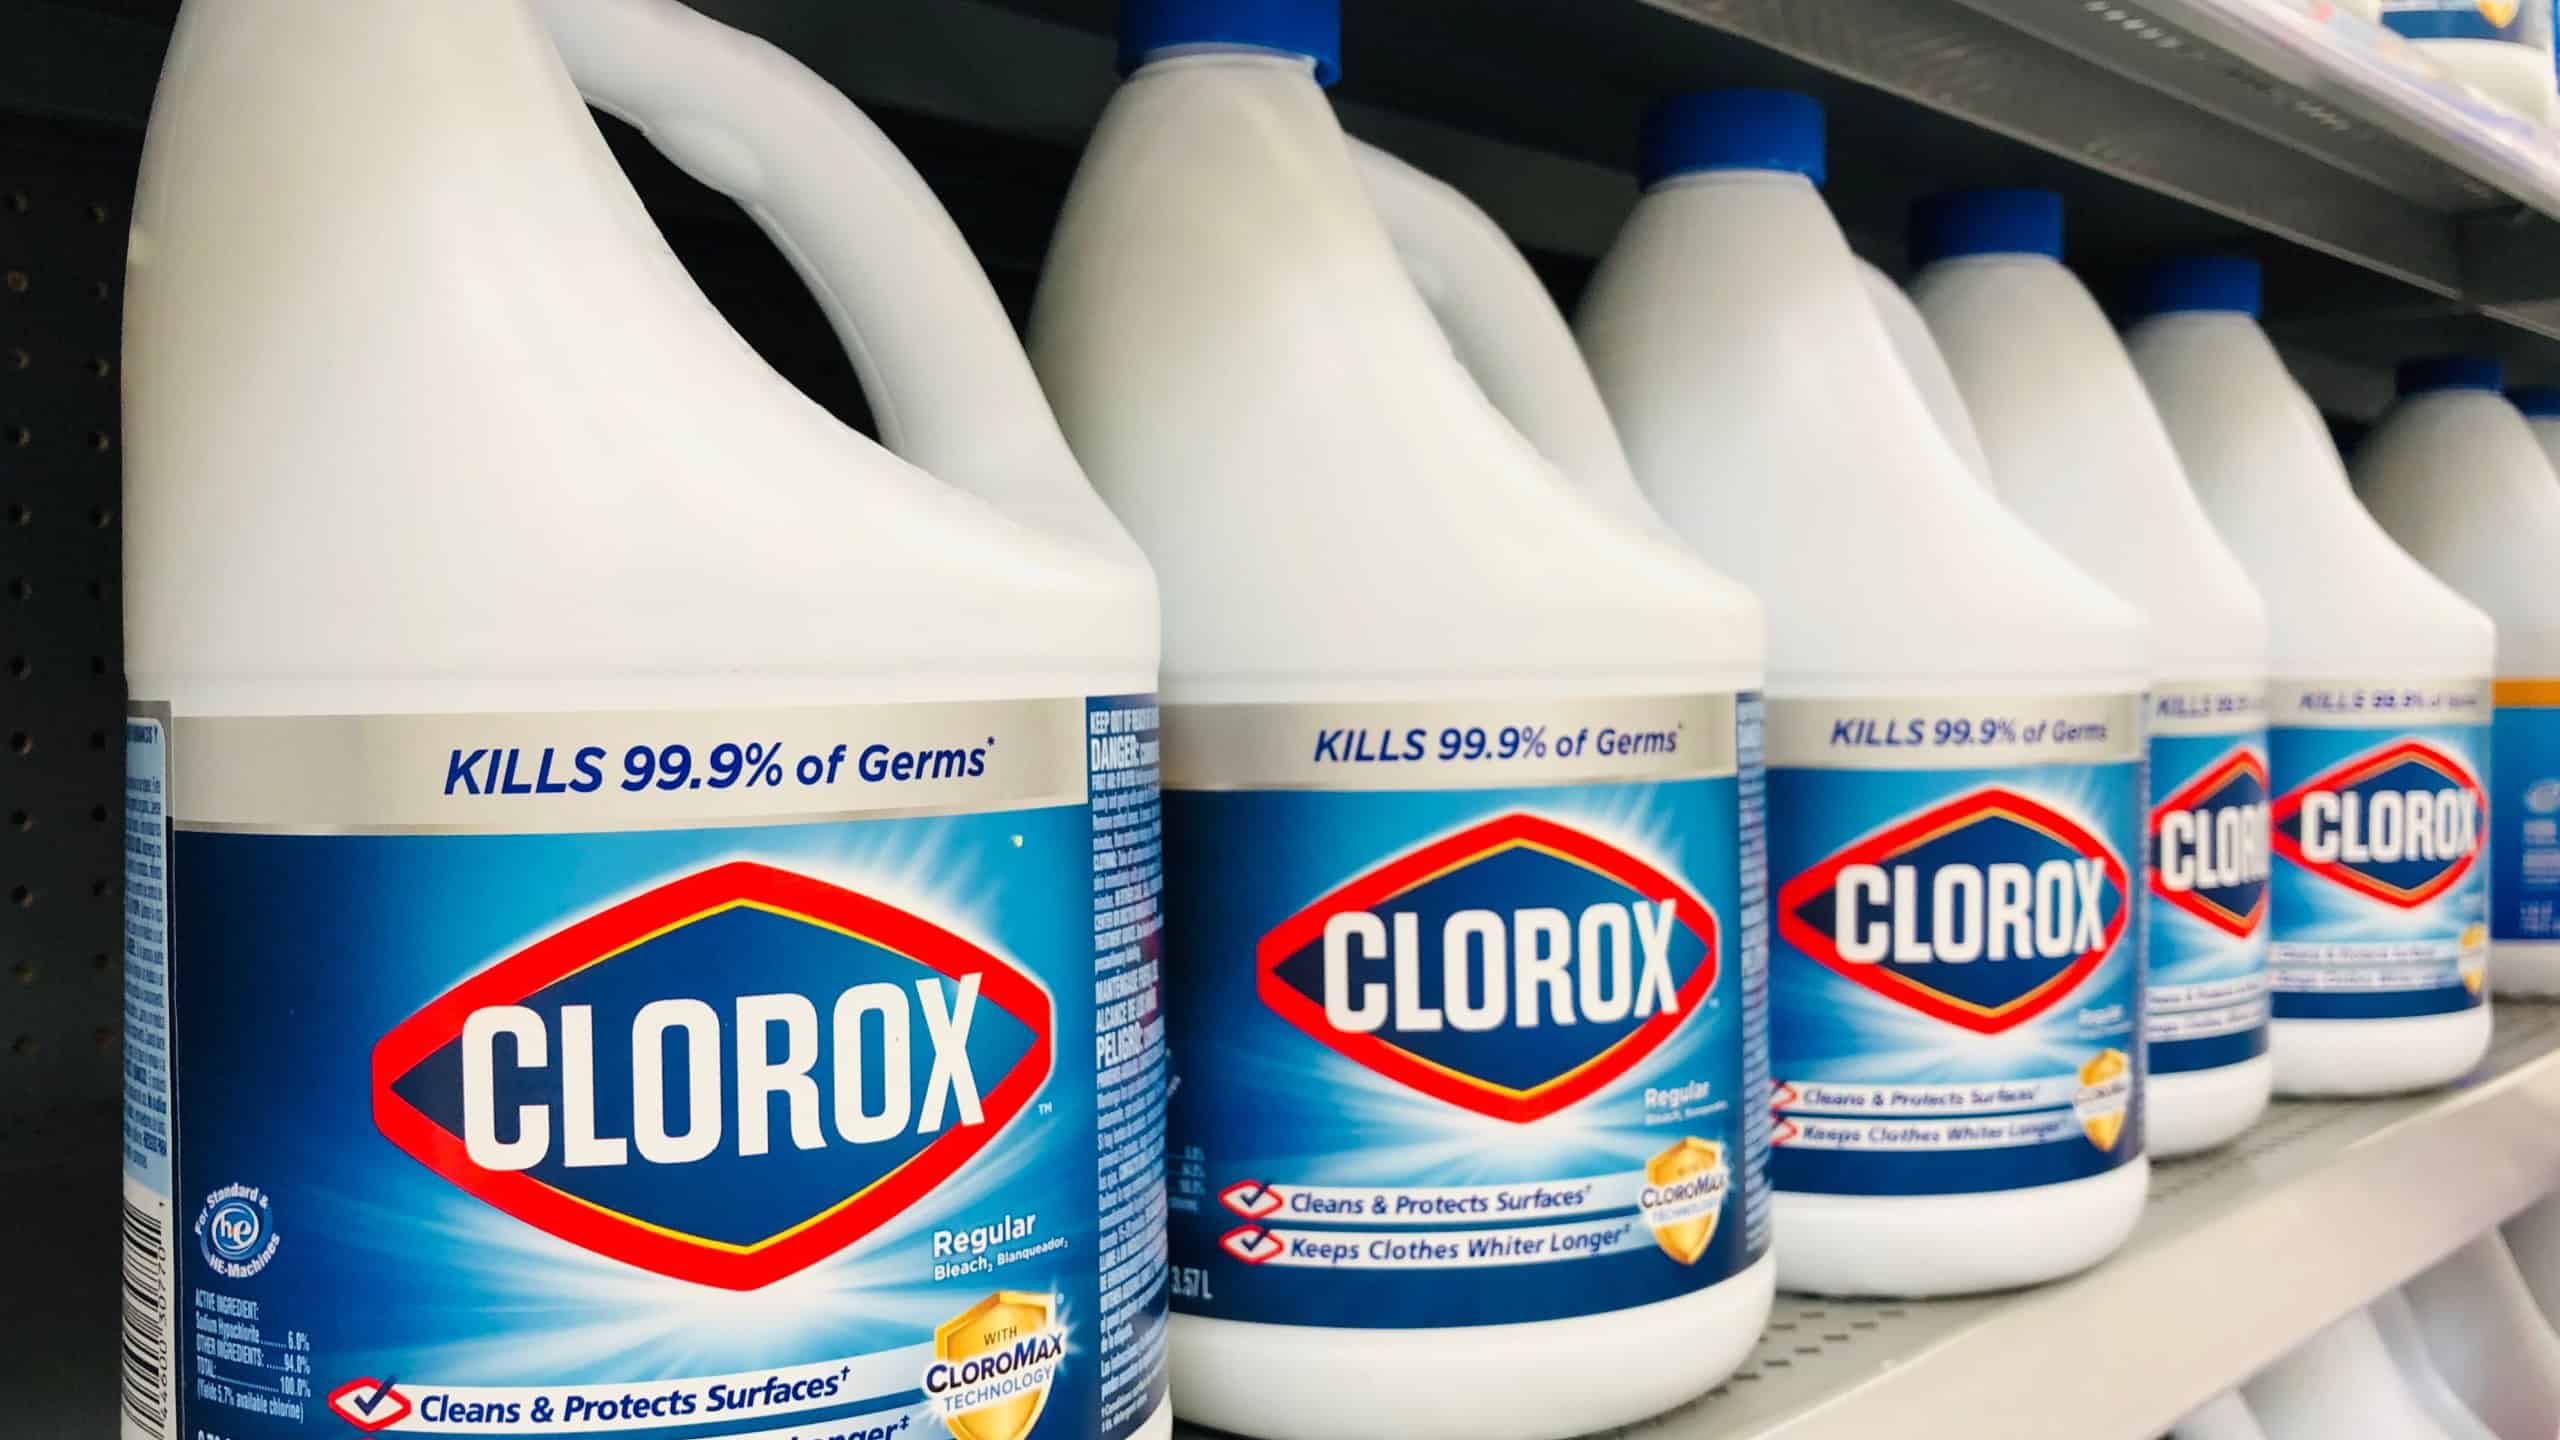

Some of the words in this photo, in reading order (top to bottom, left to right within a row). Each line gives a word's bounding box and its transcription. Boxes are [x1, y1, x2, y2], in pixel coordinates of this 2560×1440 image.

[1314, 728, 1426, 763] KILLS
[1437, 726, 1547, 762] 99.9%
[1555, 729, 1588, 758] of
[1830, 718, 1925, 747] KILLS
[1933, 717, 2016, 747] 99.9%
[2022, 720, 2047, 744] of
[444, 746, 607, 795] KILLS
[621, 741, 784, 793] 99.9%
[796, 743, 847, 786] of
[2300, 788, 2478, 864] CLOROX
[1834, 857, 2107, 964] CLOROX
[1323, 898, 1680, 1033] CLOROX
[461, 972, 986, 1172] CLOROX
[1643, 1080, 1710, 1108] Regular
[206, 1182, 260, 1210] Standard
[258, 1194, 270, 1210] &
[1290, 1190, 1364, 1217] Cleans
[1371, 1193, 1388, 1217] &
[1396, 1189, 1490, 1216] Protects
[220, 1209, 253, 1247] he
[933, 1214, 1037, 1260] Regular
[209, 1232, 281, 1279] HE-Machines
[1290, 1236, 1360, 1265] Keeps
[1368, 1236, 1459, 1262] Clothes
[1466, 1233, 1543, 1259] Whiter
[934, 1254, 994, 1283] Bleach,
[195, 1287, 216, 1311] ACTIVE
[983, 1325, 1018, 1347] WITH
[420, 1393, 521, 1425] Cleans
[529, 1394, 556, 1424] &
[562, 1386, 697, 1423] Protects
[944, 1364, 1054, 1412] TECHNOLOGY
